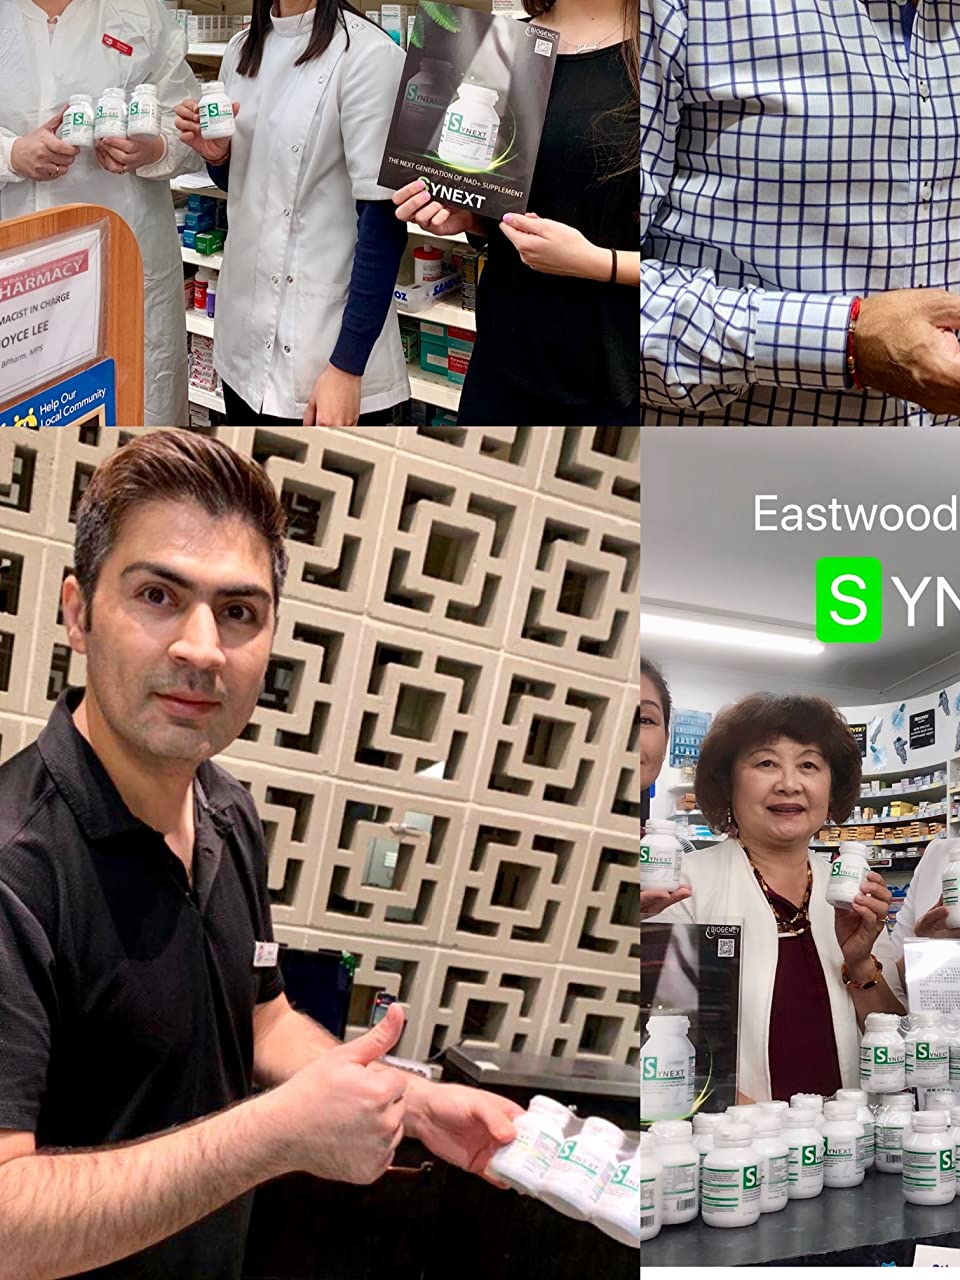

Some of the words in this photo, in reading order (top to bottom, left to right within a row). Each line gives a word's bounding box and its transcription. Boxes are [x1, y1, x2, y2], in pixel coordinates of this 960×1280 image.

[388, 156, 399, 165] THE
[399, 159, 415, 169] NEXT
[415, 162, 453, 180] GENERATION
[454, 174, 462, 182] OF
[482, 181, 524, 198] SUPPLEMENT
[30, 303, 39, 313] IN
[40, 291, 71, 310] CHARGE
[32, 320, 49, 337] LEE
[40, 399, 59, 416] Help
[61, 389, 77, 405] Our
[40, 411, 62, 426] Local
[63, 387, 106, 415] Community
